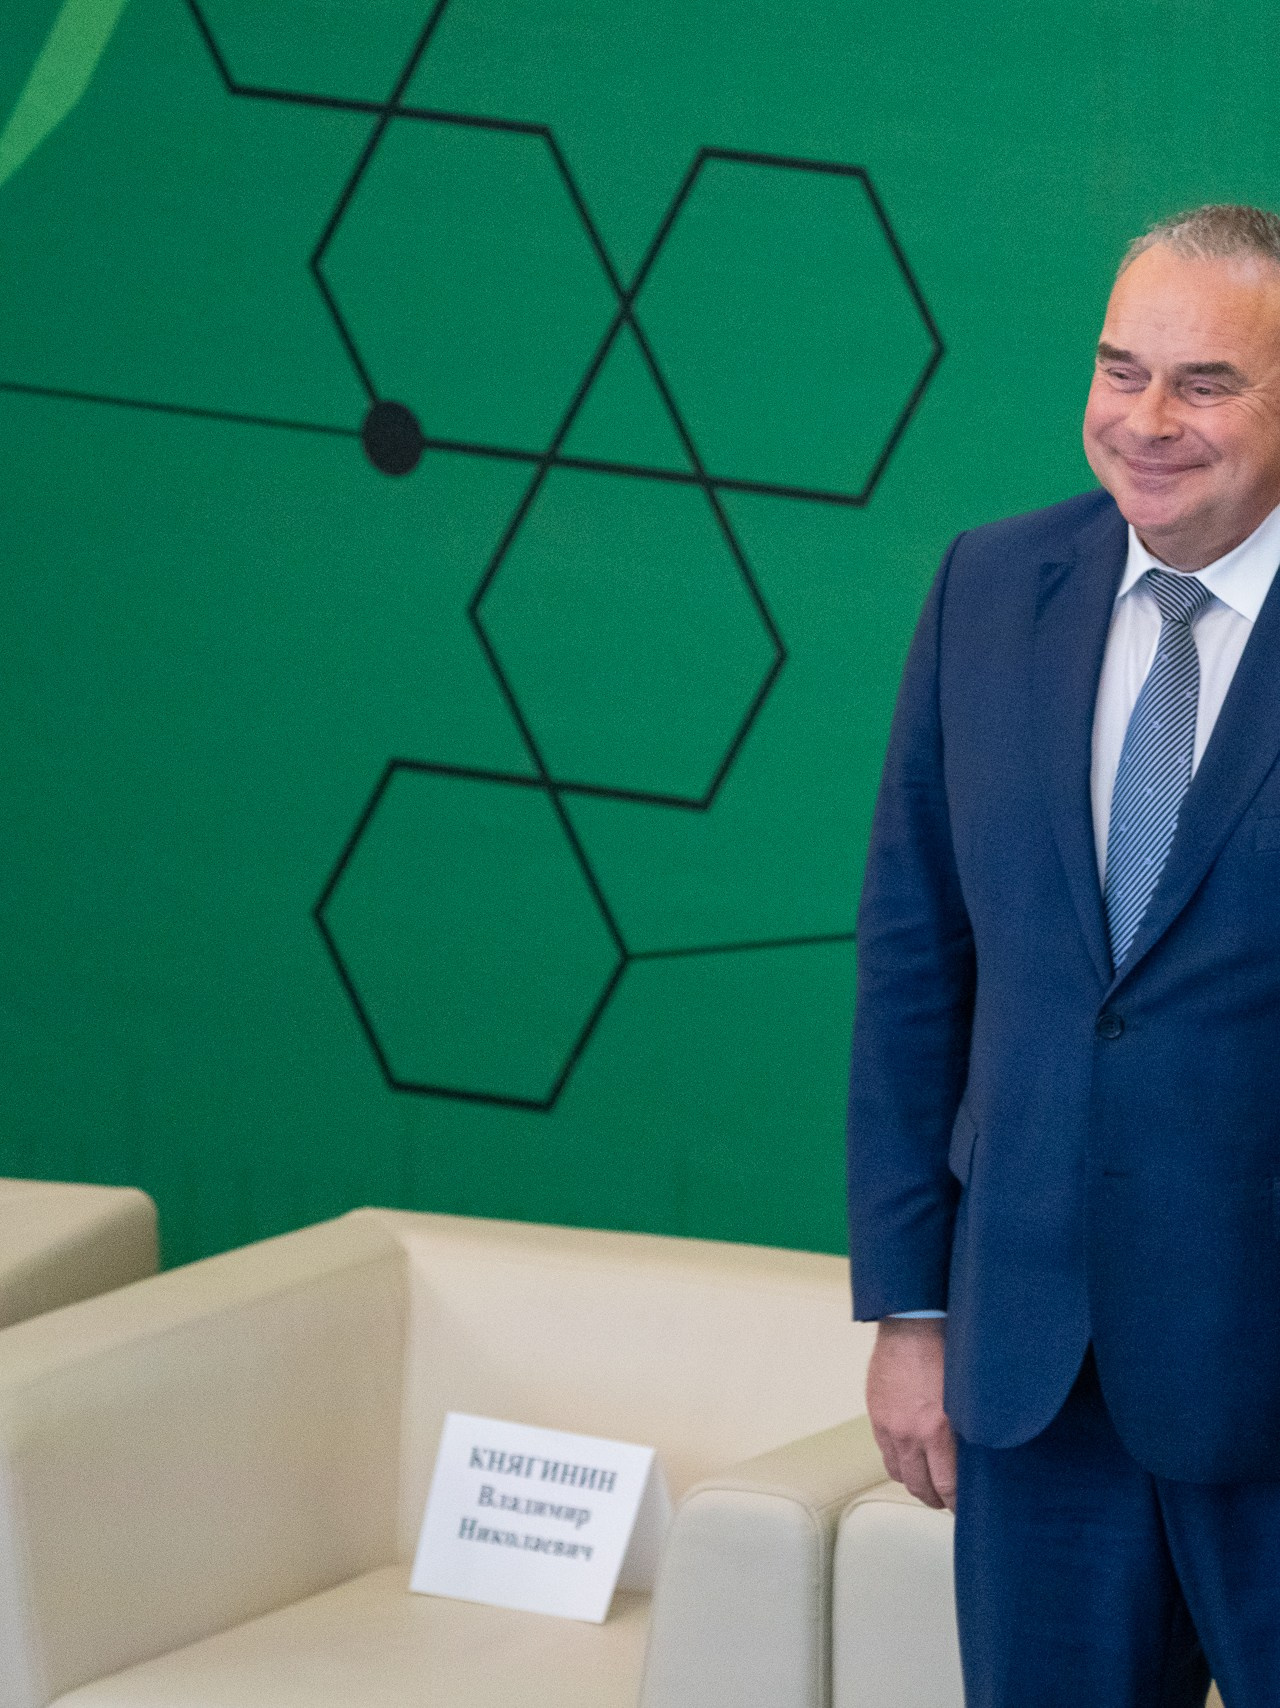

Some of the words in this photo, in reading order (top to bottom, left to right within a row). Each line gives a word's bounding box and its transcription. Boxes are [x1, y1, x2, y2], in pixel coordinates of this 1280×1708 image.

[468, 1446, 617, 1491] КНЯГИНИН
[477, 1484, 590, 1529] Владимир
[458, 1516, 594, 1561] Николаевич
